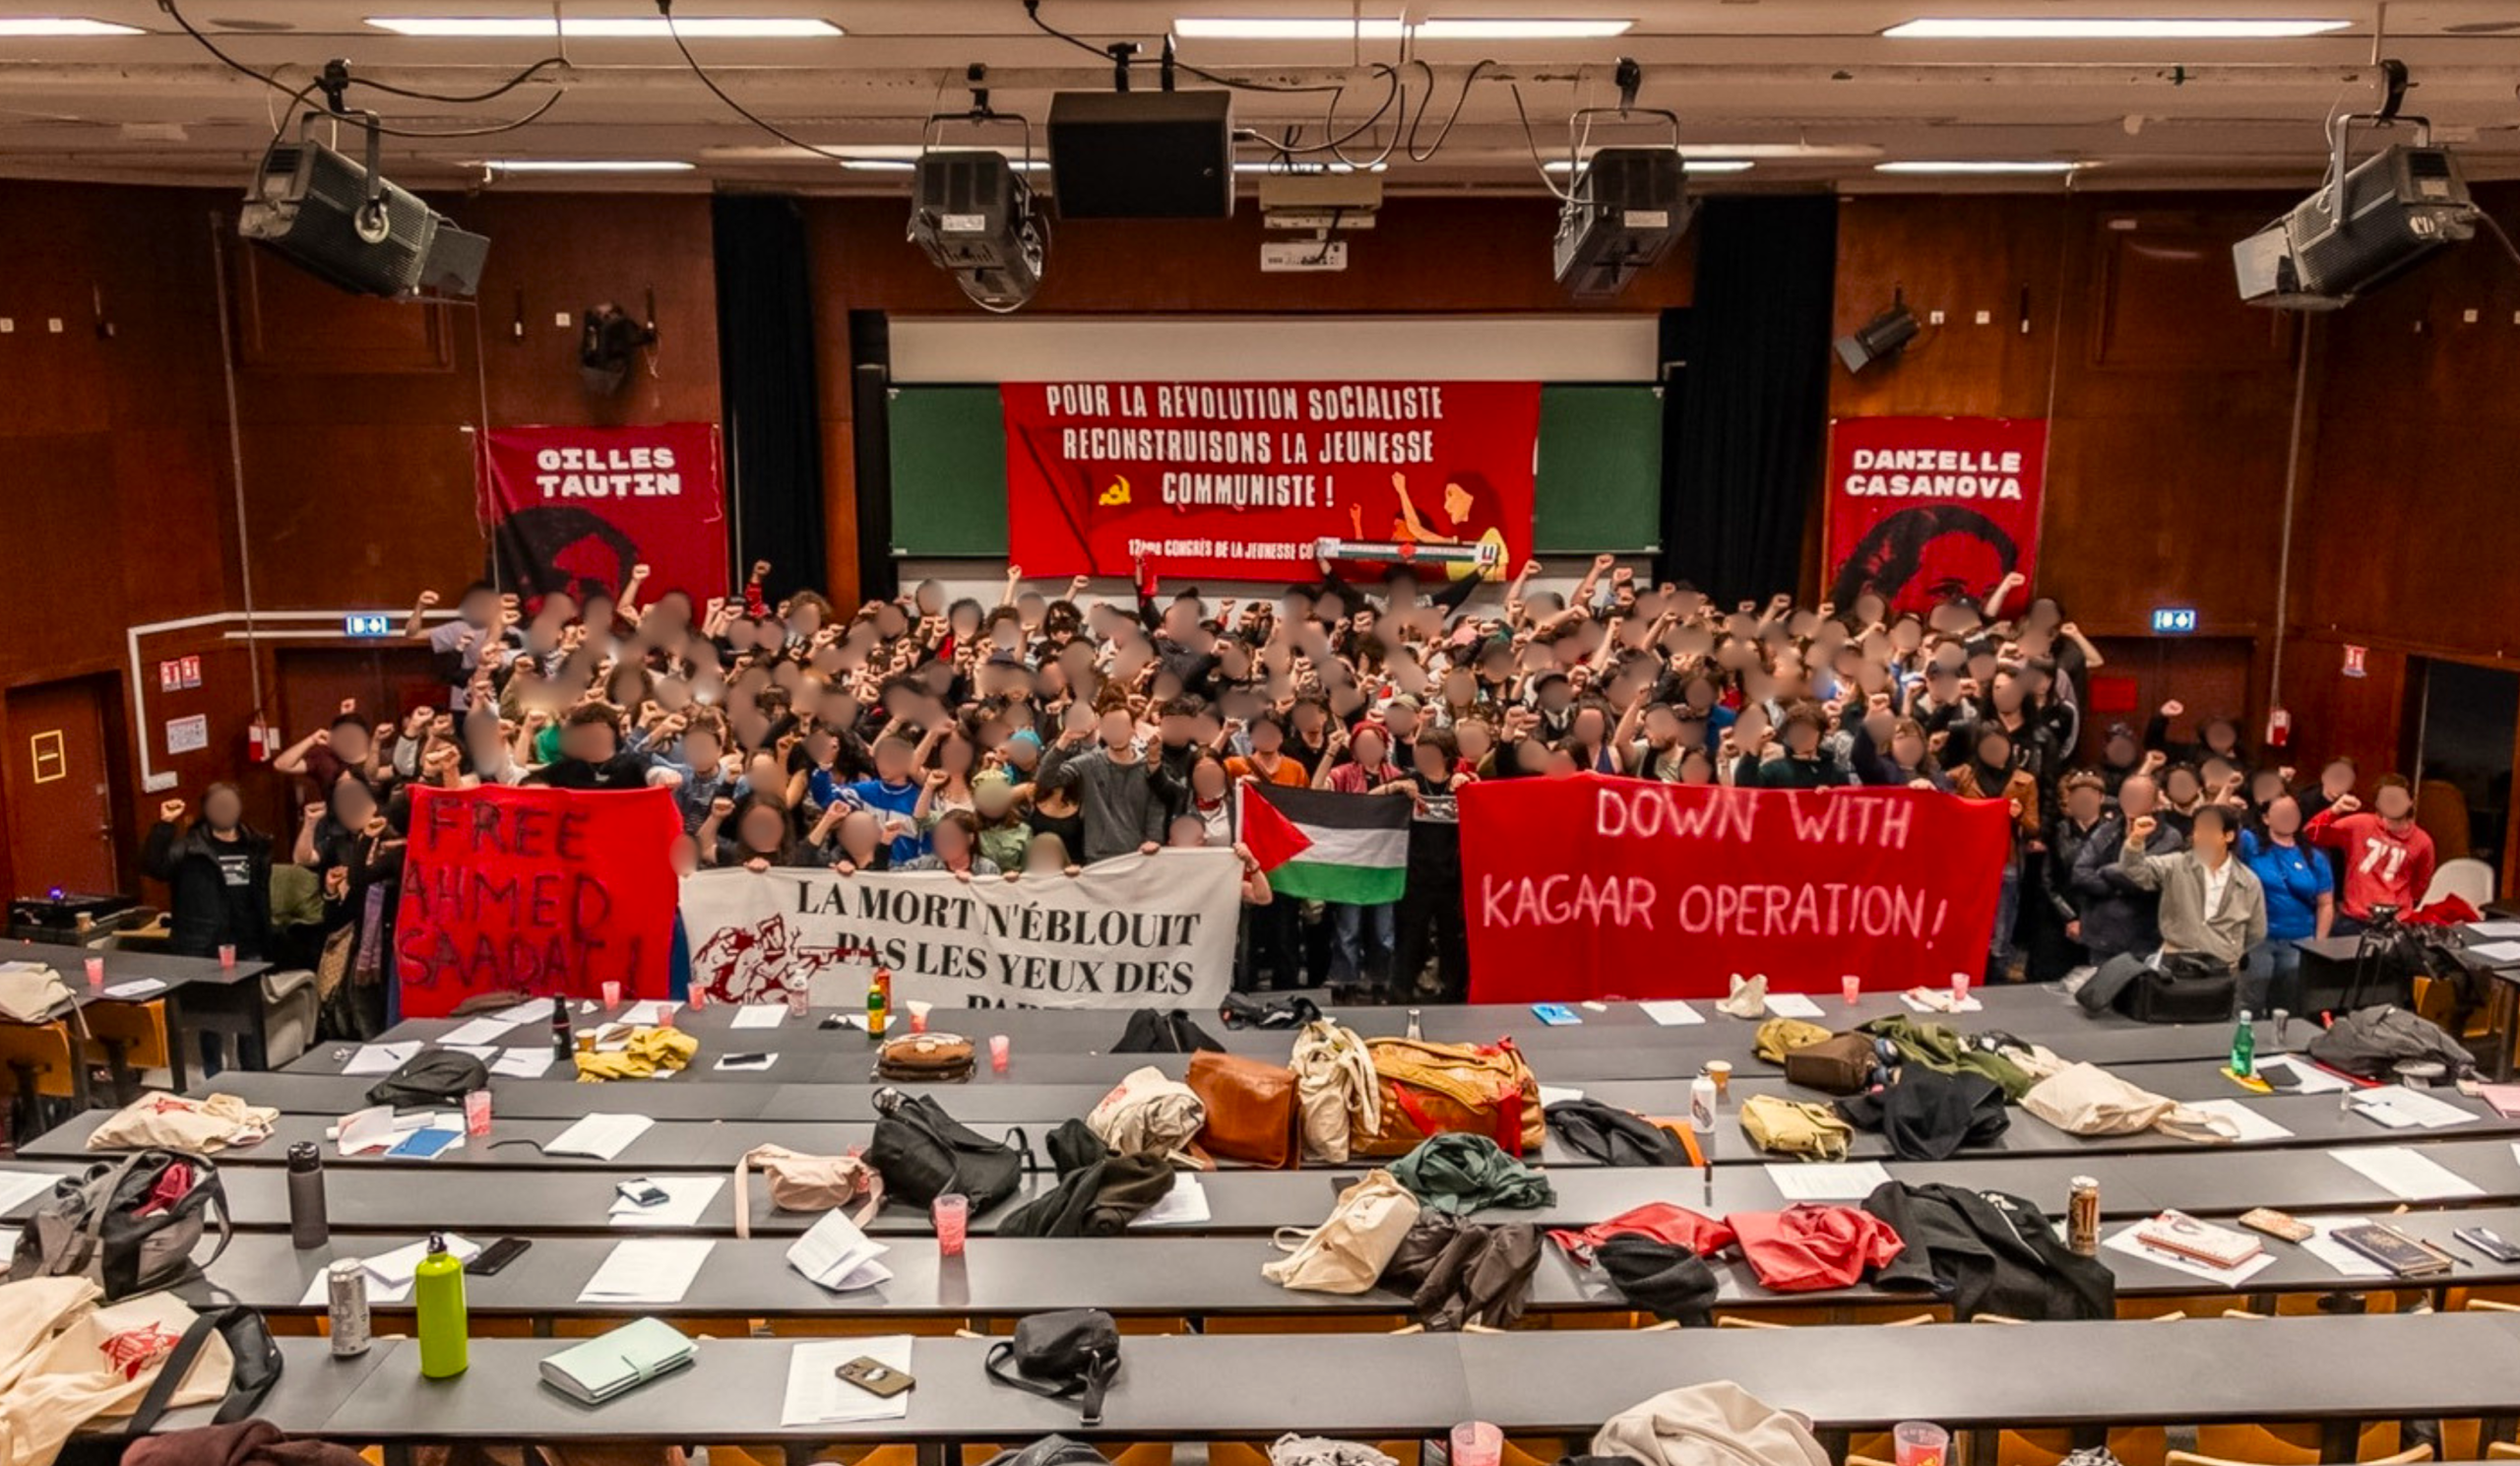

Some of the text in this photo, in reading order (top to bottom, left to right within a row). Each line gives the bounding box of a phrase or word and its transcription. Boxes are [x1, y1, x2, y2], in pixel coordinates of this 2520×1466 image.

[1046, 384, 1110, 416] POUR
[1120, 385, 1148, 417] LA
[1308, 385, 1443, 420] SOCIALISTE
[536, 448, 675, 471] GILLES
[1063, 427, 1433, 464] RECONSTRUISONS LA JEUNESSE
[1854, 449, 2021, 473] DANIELLE
[536, 474, 681, 498] TAUTIN
[1163, 472, 1334, 507] COMMUNISTE !
[1846, 475, 2022, 500] CASANOVA
[1215, 541, 1228, 558] DE
[1230, 541, 1243, 558] LA
[1244, 542, 1295, 560] JEUNESSE
[427, 797, 588, 860] FREE
[1598, 784, 1913, 850] DOWN WITH
[402, 859, 611, 939] AHMED
[796, 880, 1201, 948] LA MORT N'ÉBLOUIT
[1482, 873, 1654, 930] KAGAAR
[836, 931, 1194, 995] PAS LES YEUX DES
